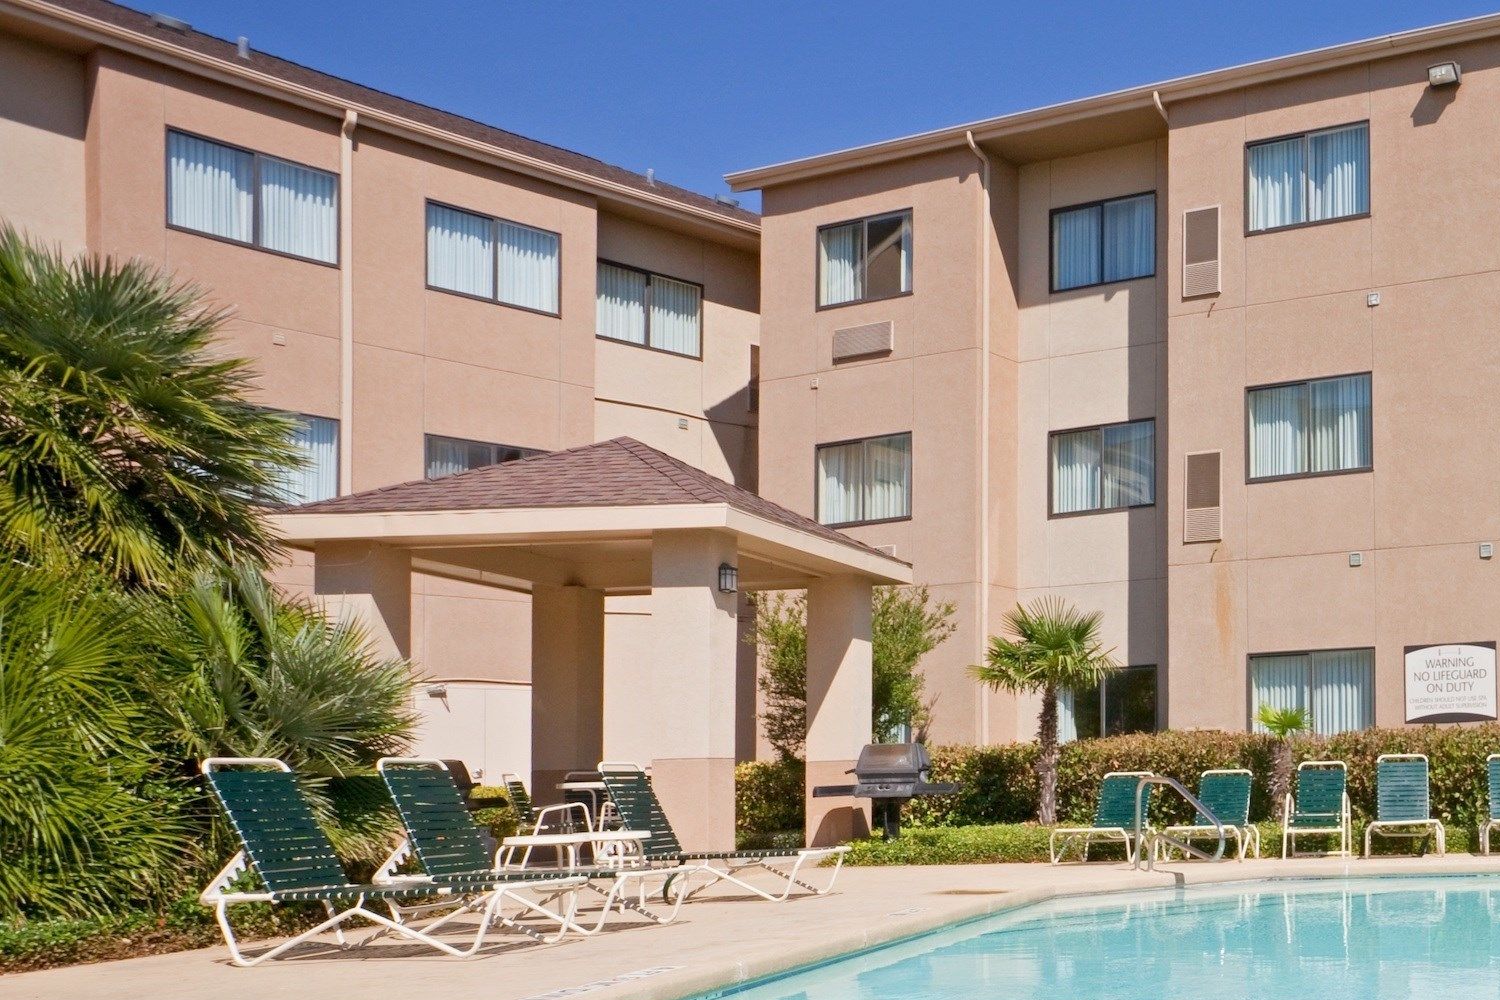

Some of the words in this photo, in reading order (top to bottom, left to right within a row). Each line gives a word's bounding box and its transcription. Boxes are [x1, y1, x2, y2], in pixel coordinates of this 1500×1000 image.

[1425, 657, 1475, 668] WARNING
[1413, 671, 1430, 682] NO
[1433, 668, 1487, 681] LIFEGUARD
[1426, 683, 1443, 693] ON
[1446, 681, 1474, 693] DUTY
